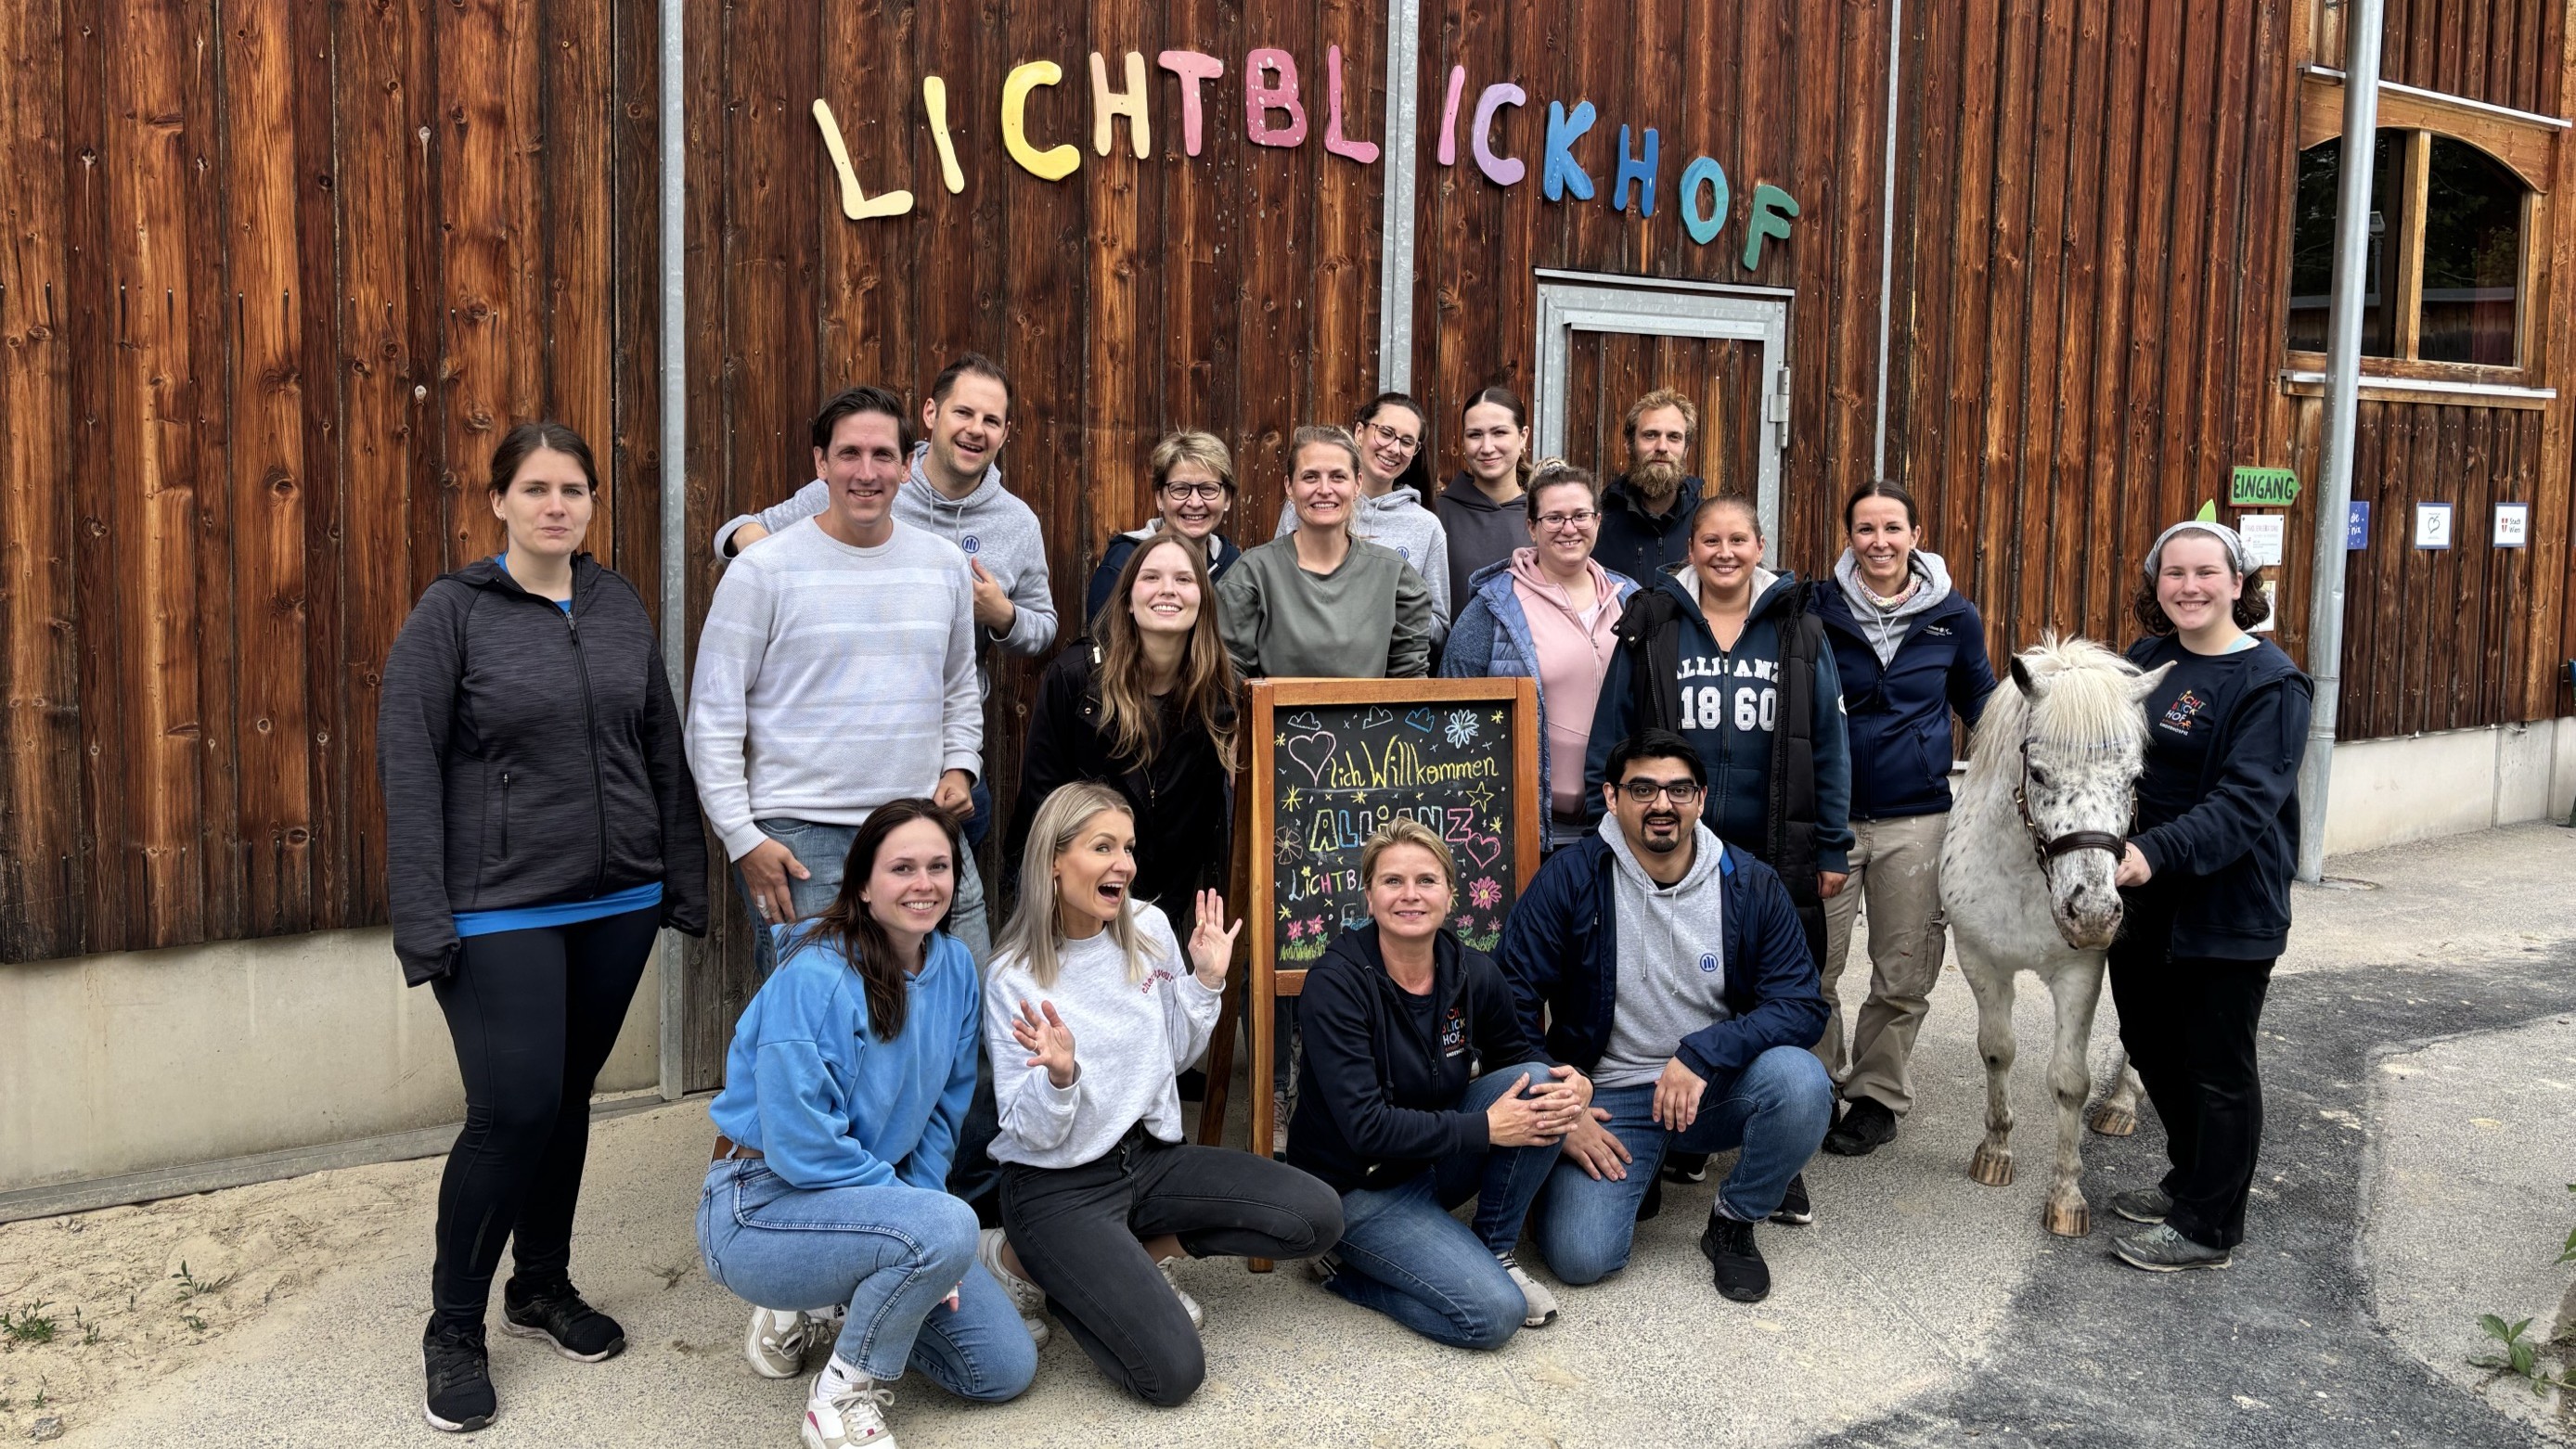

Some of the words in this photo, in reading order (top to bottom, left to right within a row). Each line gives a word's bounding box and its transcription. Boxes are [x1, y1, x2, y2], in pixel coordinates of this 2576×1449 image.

[812, 45, 1800, 272] LICHTBLICKHOF
[2233, 474, 2295, 500] EINGANG
[2171, 700, 2199, 715] BLICK
[2177, 690, 2207, 710] LICHT
[2165, 710, 2187, 722] HOF
[1361, 733, 1500, 789] Willkommen
[1288, 866, 1365, 902] LiCHTBL
[1442, 1031, 1460, 1045] HOF
